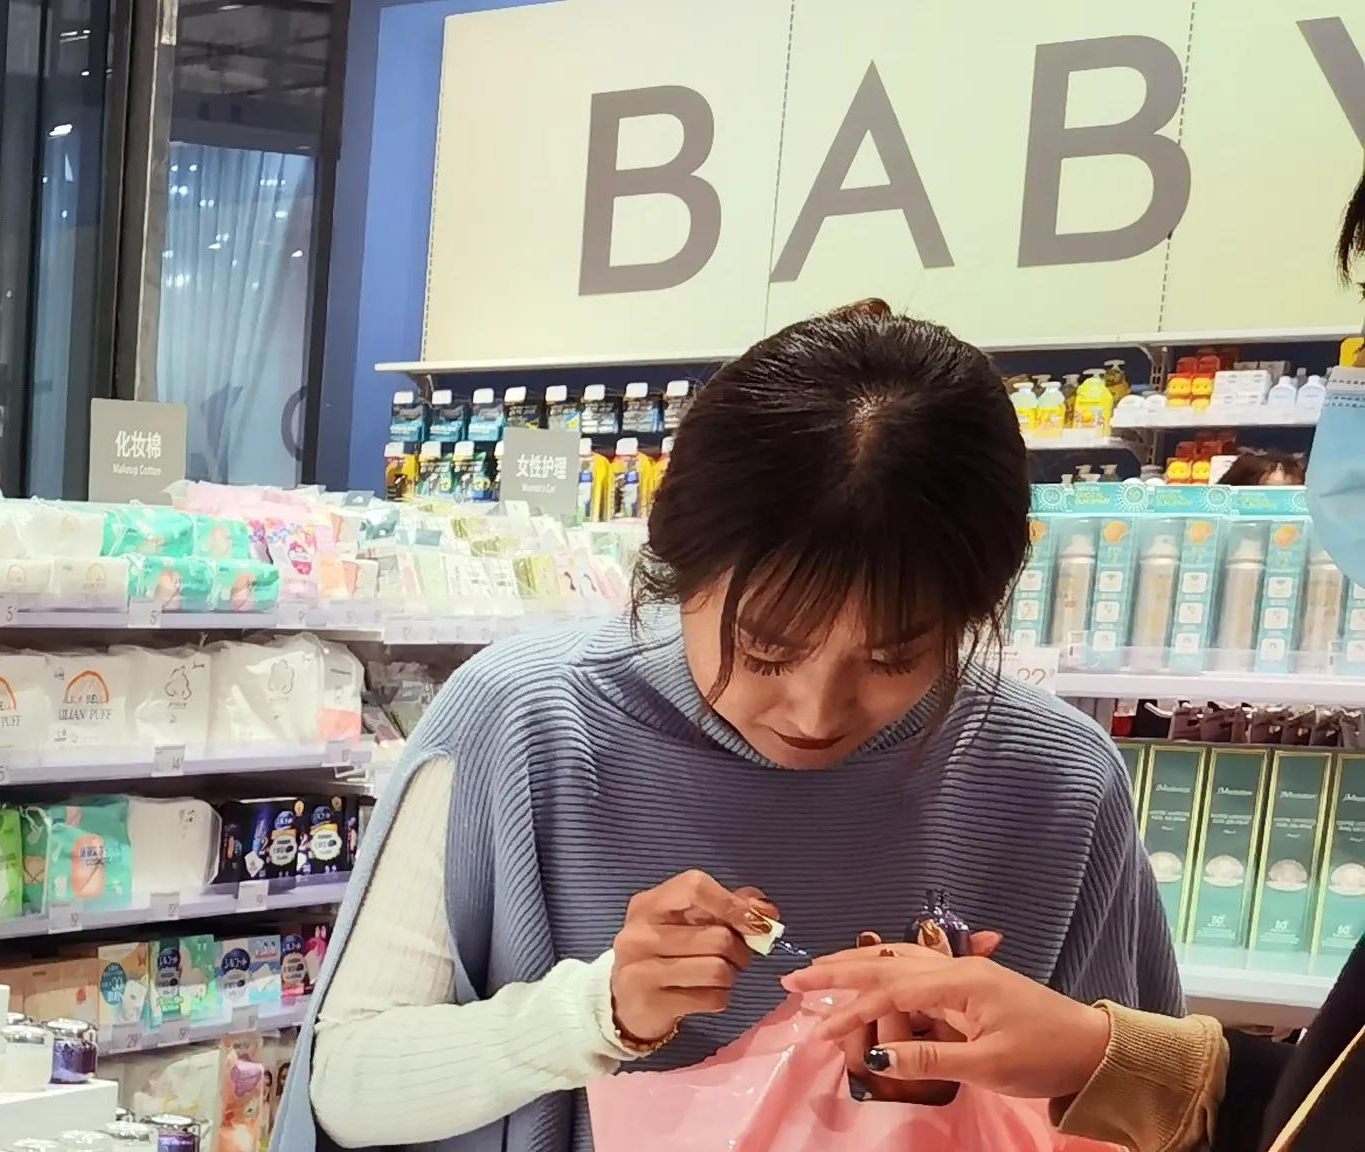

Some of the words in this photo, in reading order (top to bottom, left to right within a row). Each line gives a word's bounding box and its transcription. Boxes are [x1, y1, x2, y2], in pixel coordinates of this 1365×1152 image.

[115, 430, 162, 460] 化妆棉
[516, 453, 567, 479] 女性护理
